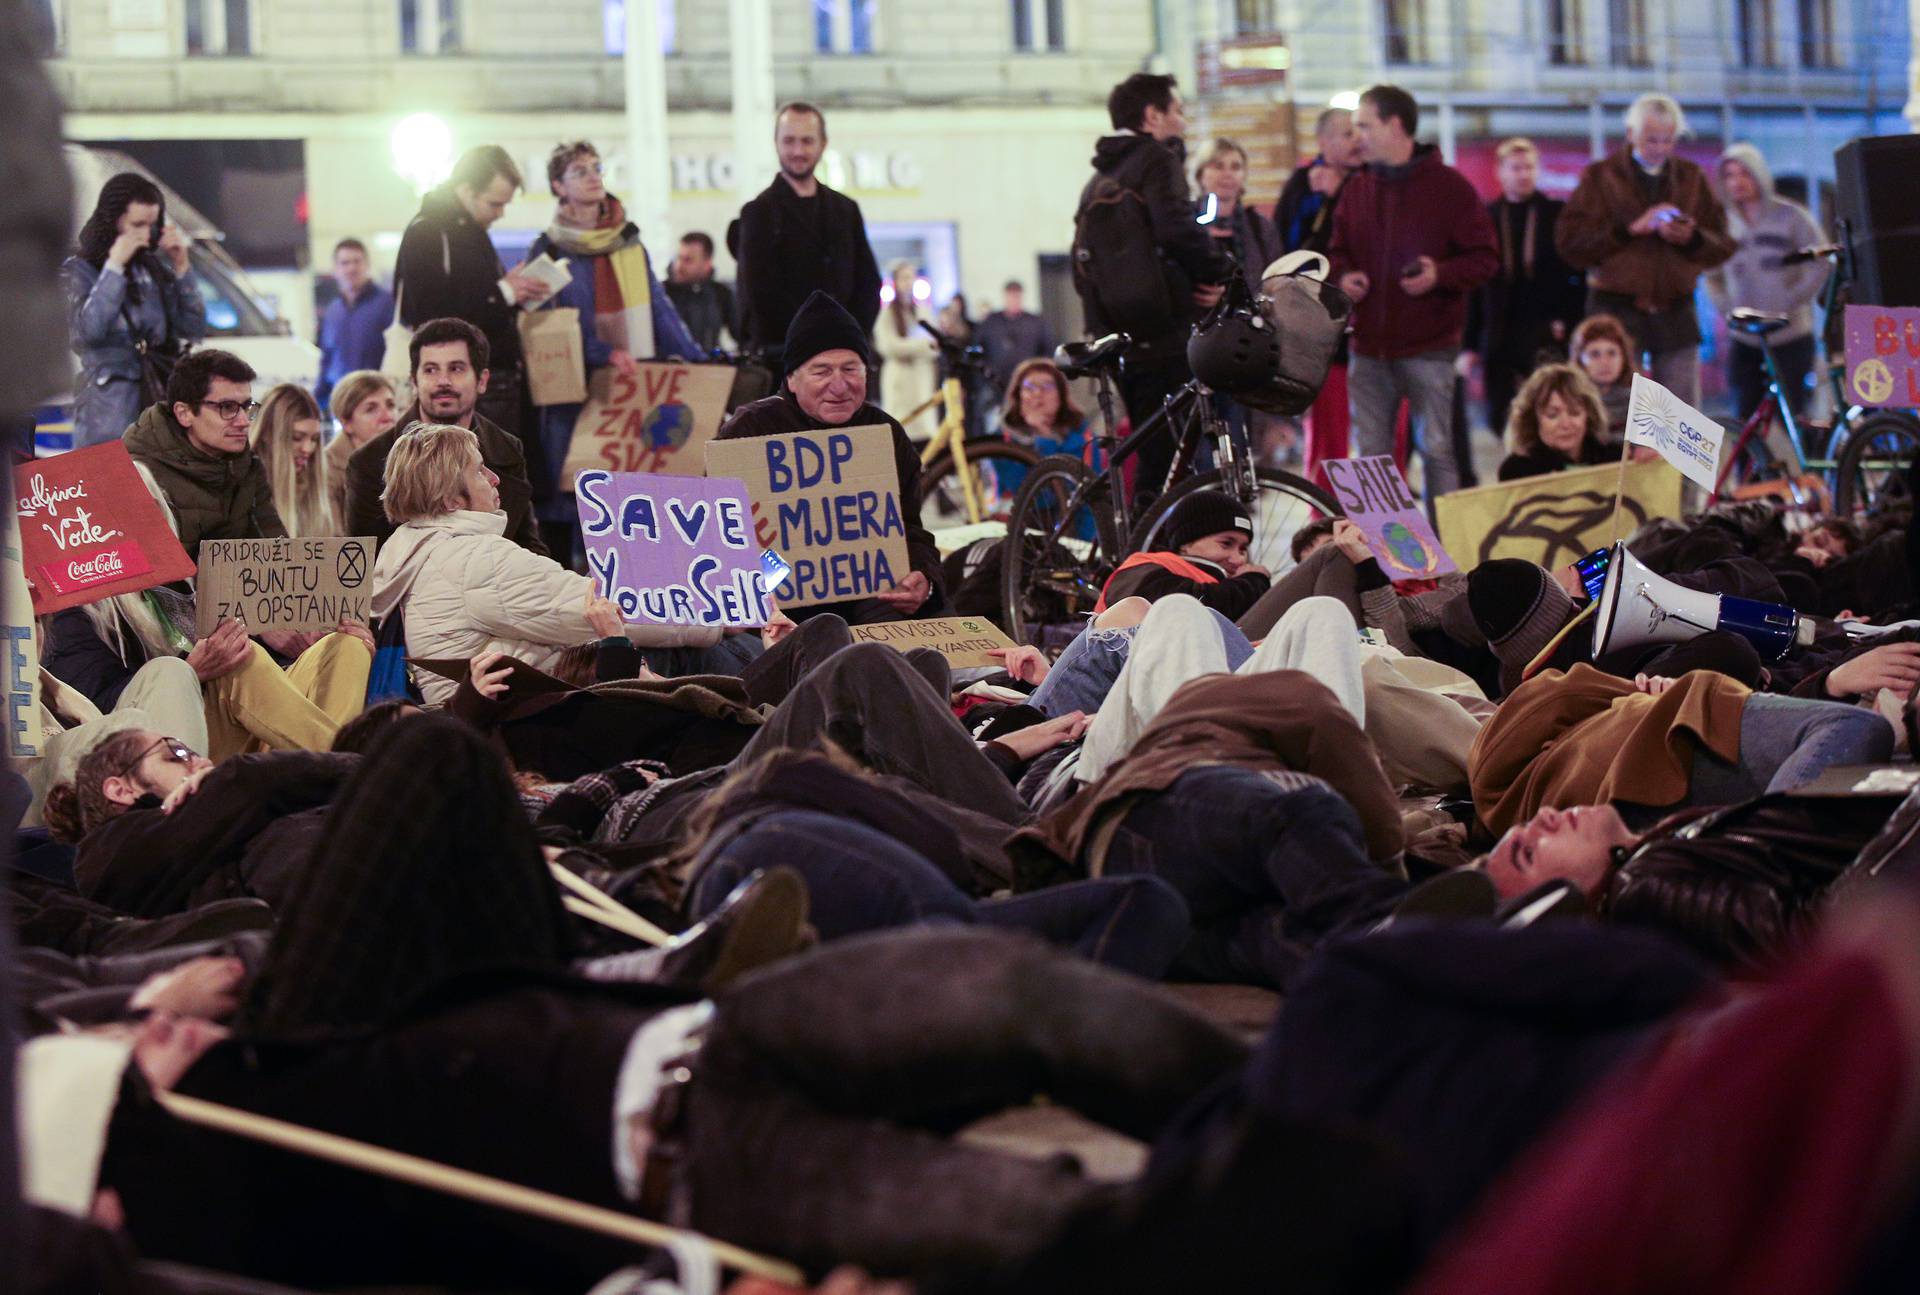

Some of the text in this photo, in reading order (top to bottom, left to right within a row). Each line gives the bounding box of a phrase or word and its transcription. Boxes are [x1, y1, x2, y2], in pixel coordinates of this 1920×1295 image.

[614, 368, 690, 406] SVE
[594, 407, 643, 440] ZA
[1679, 421, 1716, 454] COP27
[766, 434, 853, 493] BDP
[1326, 457, 1416, 514] SAVE
[574, 469, 749, 549] SAVE
[778, 490, 905, 551] MJERA
[68, 550, 123, 581] Coca-Cola
[210, 539, 325, 567] PRIDRUŽI SE
[238, 565, 320, 598] BUNTU
[215, 594, 365, 627] ZA OPSTANAK
[855, 621, 956, 642] ACTIVISTS
